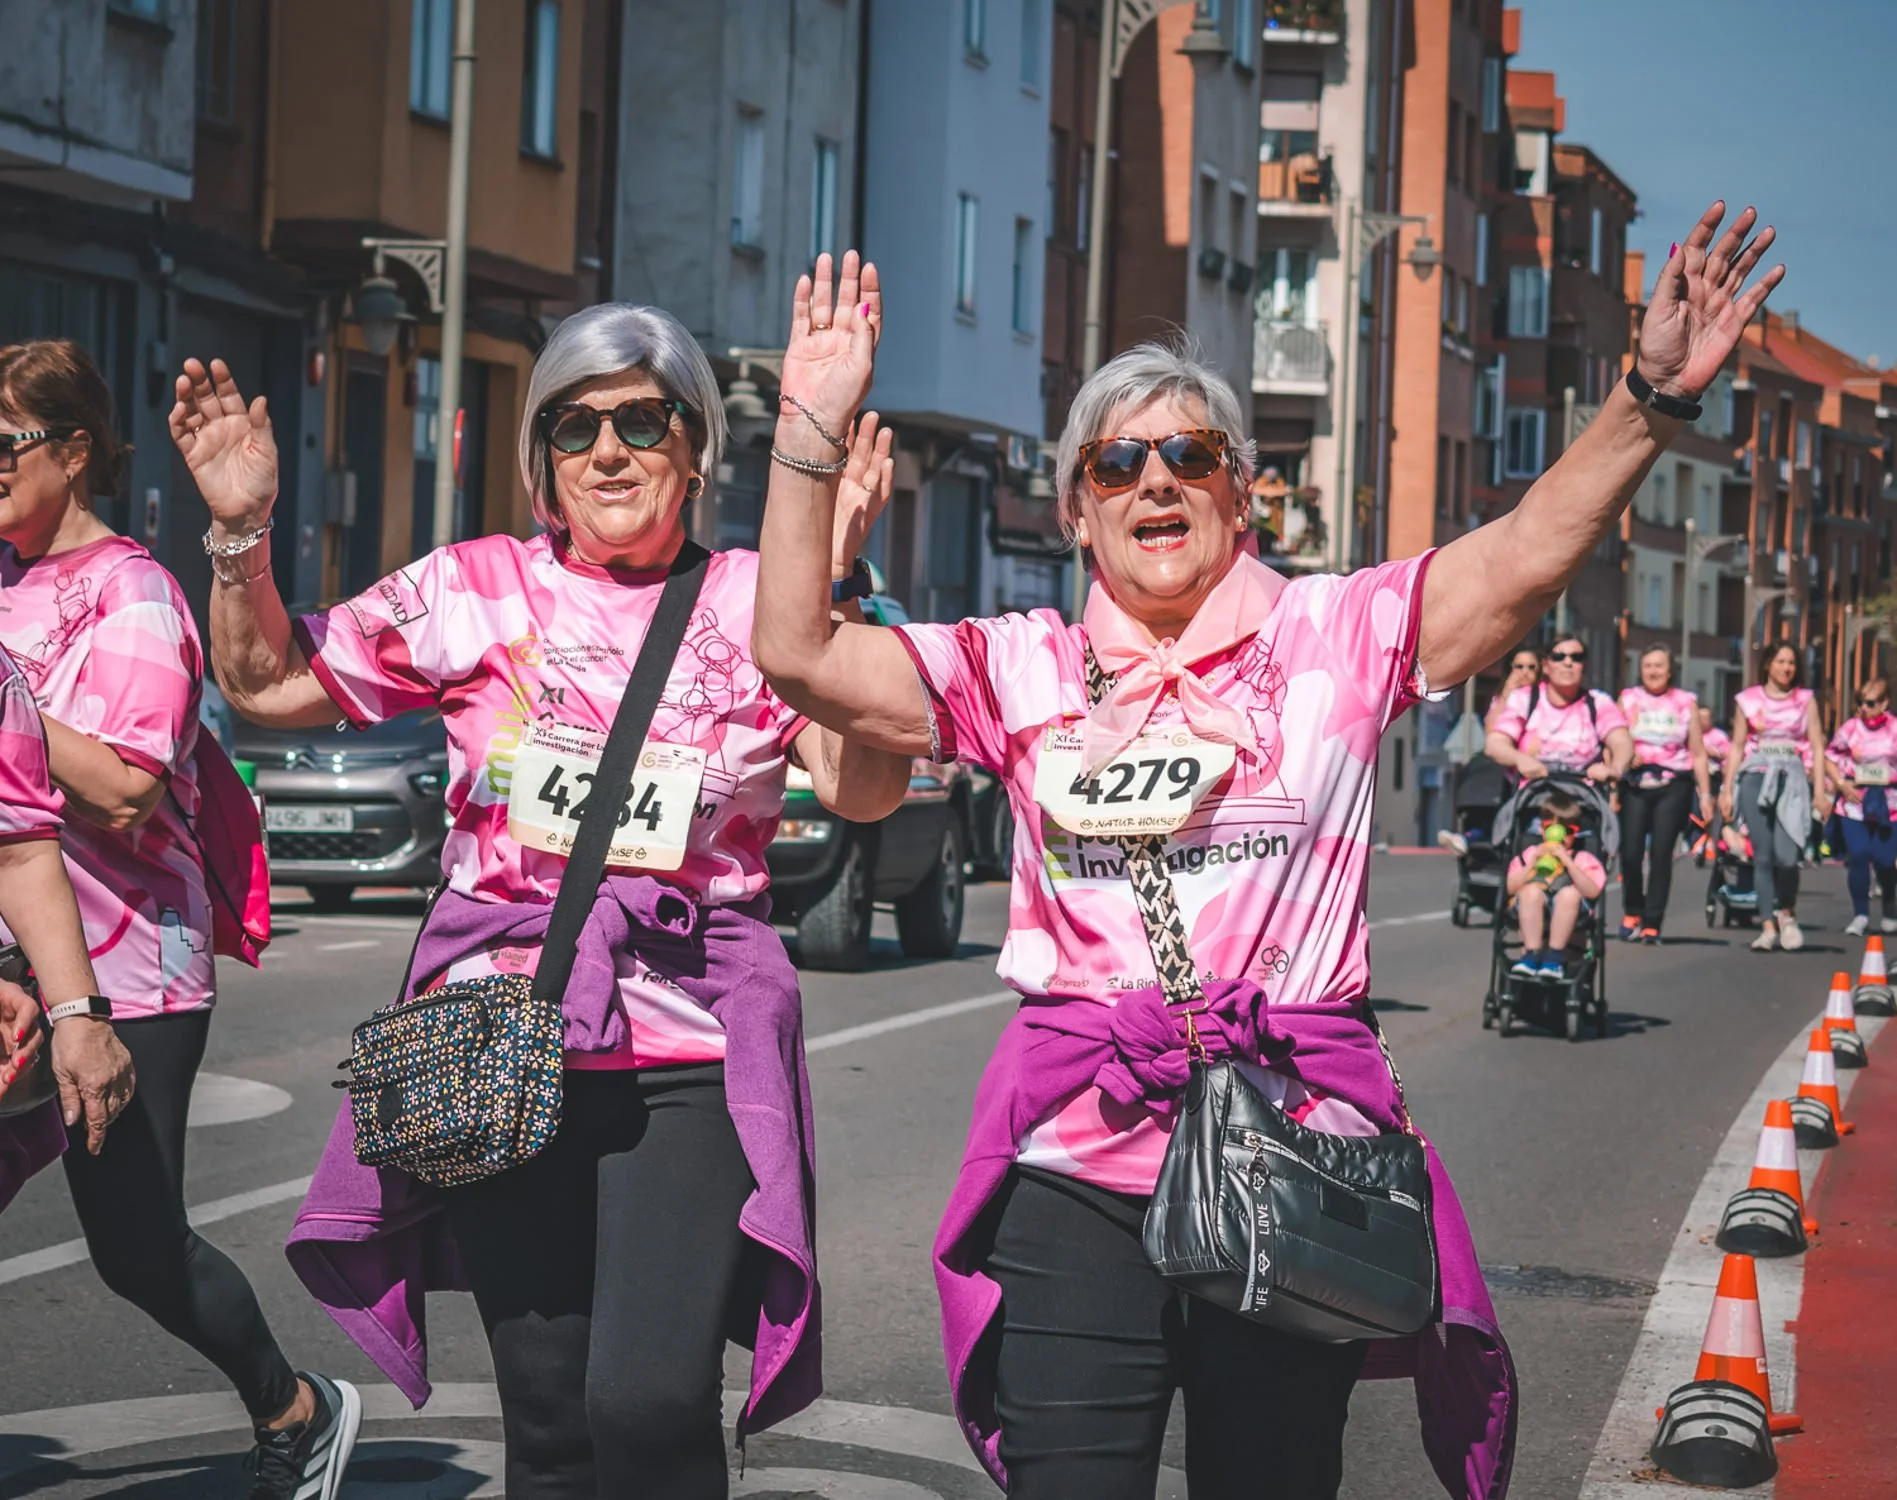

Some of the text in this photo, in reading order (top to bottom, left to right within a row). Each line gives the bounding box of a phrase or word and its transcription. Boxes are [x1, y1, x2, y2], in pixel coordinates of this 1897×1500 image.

[538, 680, 565, 704] XI
[548, 732, 580, 745] Carrera
[581, 740, 596, 750] por
[1055, 733, 1067, 743] XI
[1068, 757, 1201, 805] 4279
[1095, 816, 1176, 829] NATUR HOUSE
[1077, 829, 1288, 878] Invtigación
[1121, 978, 1157, 990] La Rio
[1256, 1203, 1270, 1236] LOVE
[1254, 1286, 1269, 1312] IFE
